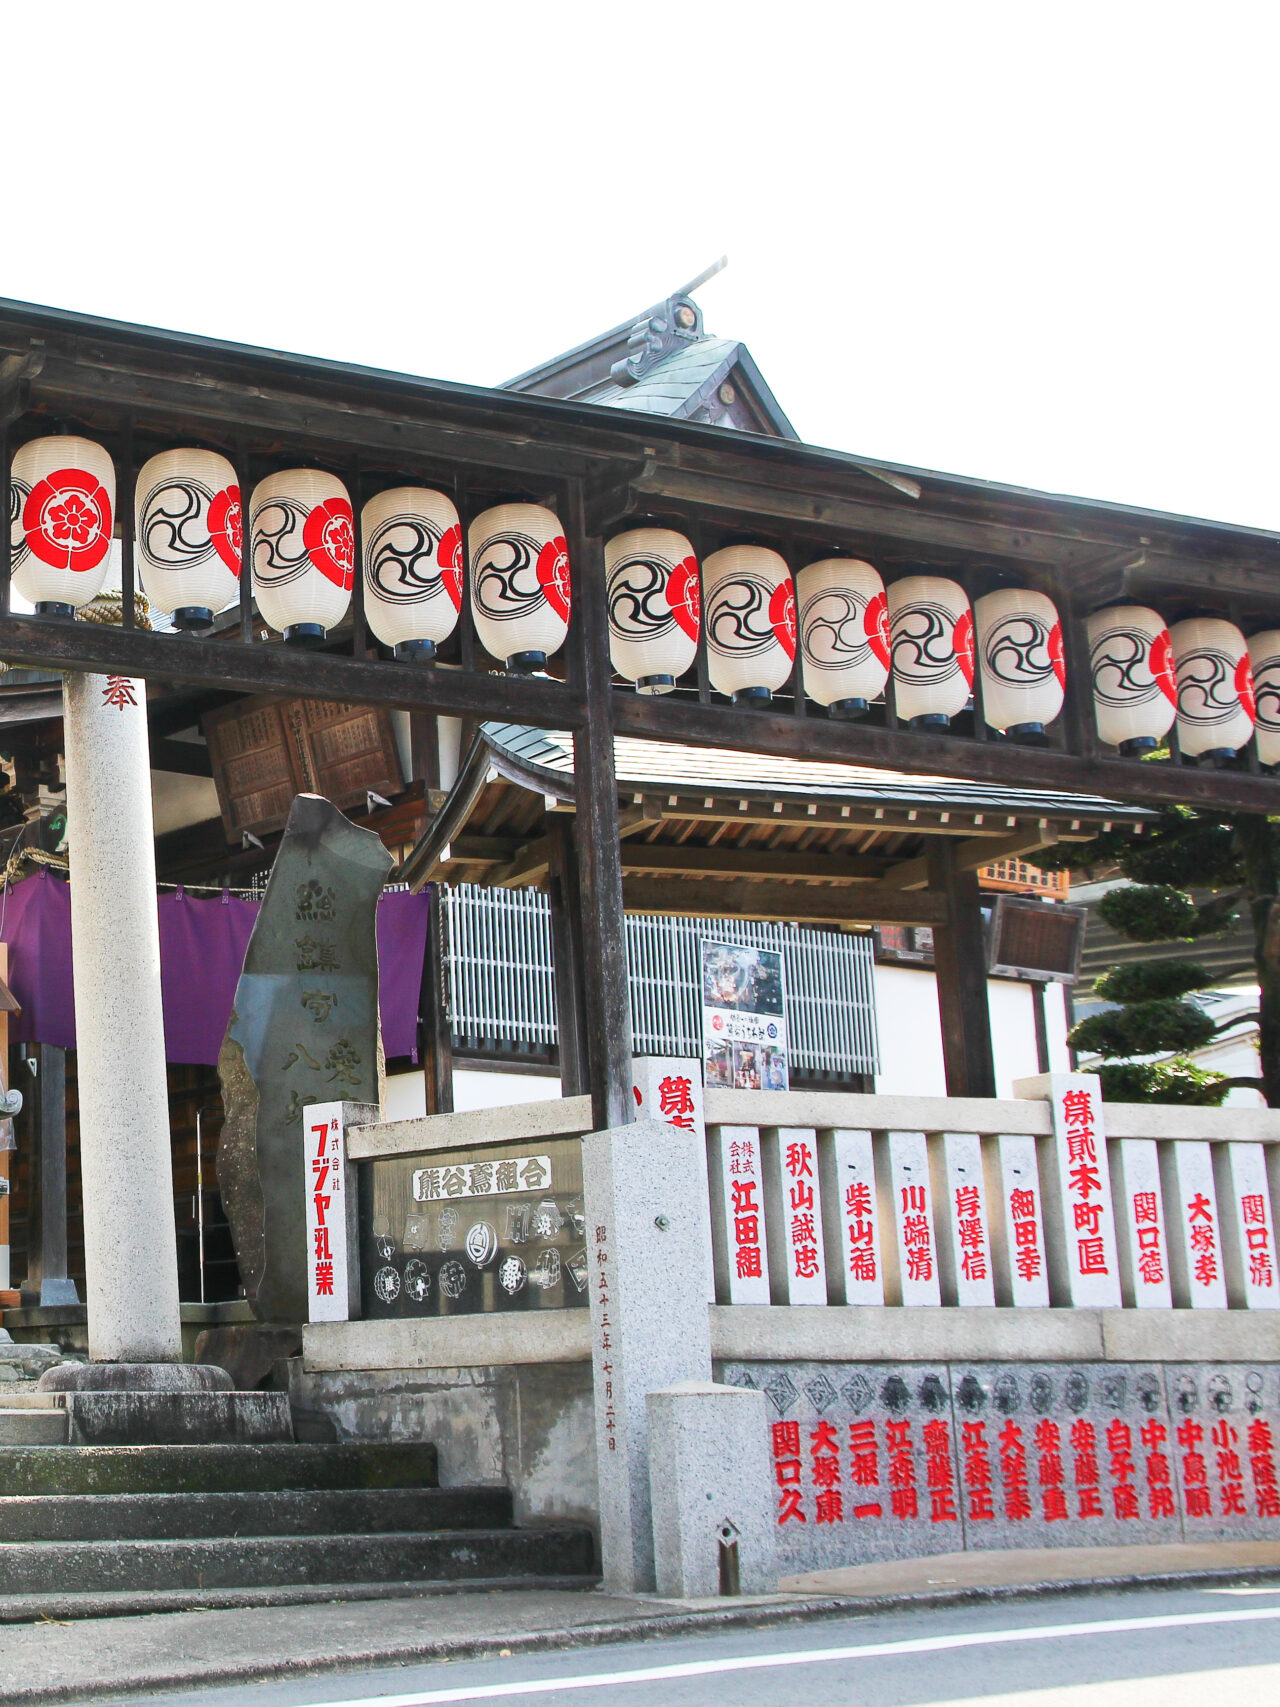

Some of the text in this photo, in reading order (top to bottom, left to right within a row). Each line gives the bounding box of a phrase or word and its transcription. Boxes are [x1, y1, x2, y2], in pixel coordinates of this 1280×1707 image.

[102, 675, 138, 711] 奉
[331, 1117, 340, 1190] 株式会社
[419, 1158, 547, 1200] 熊谷鳶組合
[311, 1123, 334, 1295] フジヤ乳業
[729, 1141, 762, 1279] 株式会社 江田組
[846, 1183, 876, 1282] 柴山福
[901, 1186, 933, 1281] 川端清
[955, 1186, 987, 1281] 岸澤信
[1010, 1188, 1041, 1282] 細田幸
[1241, 1194, 1272, 1287] 関口清
[596, 1225, 616, 1451] 昭和五十三年七月二十日
[772, 1420, 806, 1524] 関口久
[810, 1420, 843, 1524] 大塚康
[849, 1420, 883, 1519] 三根一
[885, 1419, 918, 1520] 江森明
[961, 1420, 995, 1521] 江森正
[1212, 1419, 1247, 1516] 小池光
